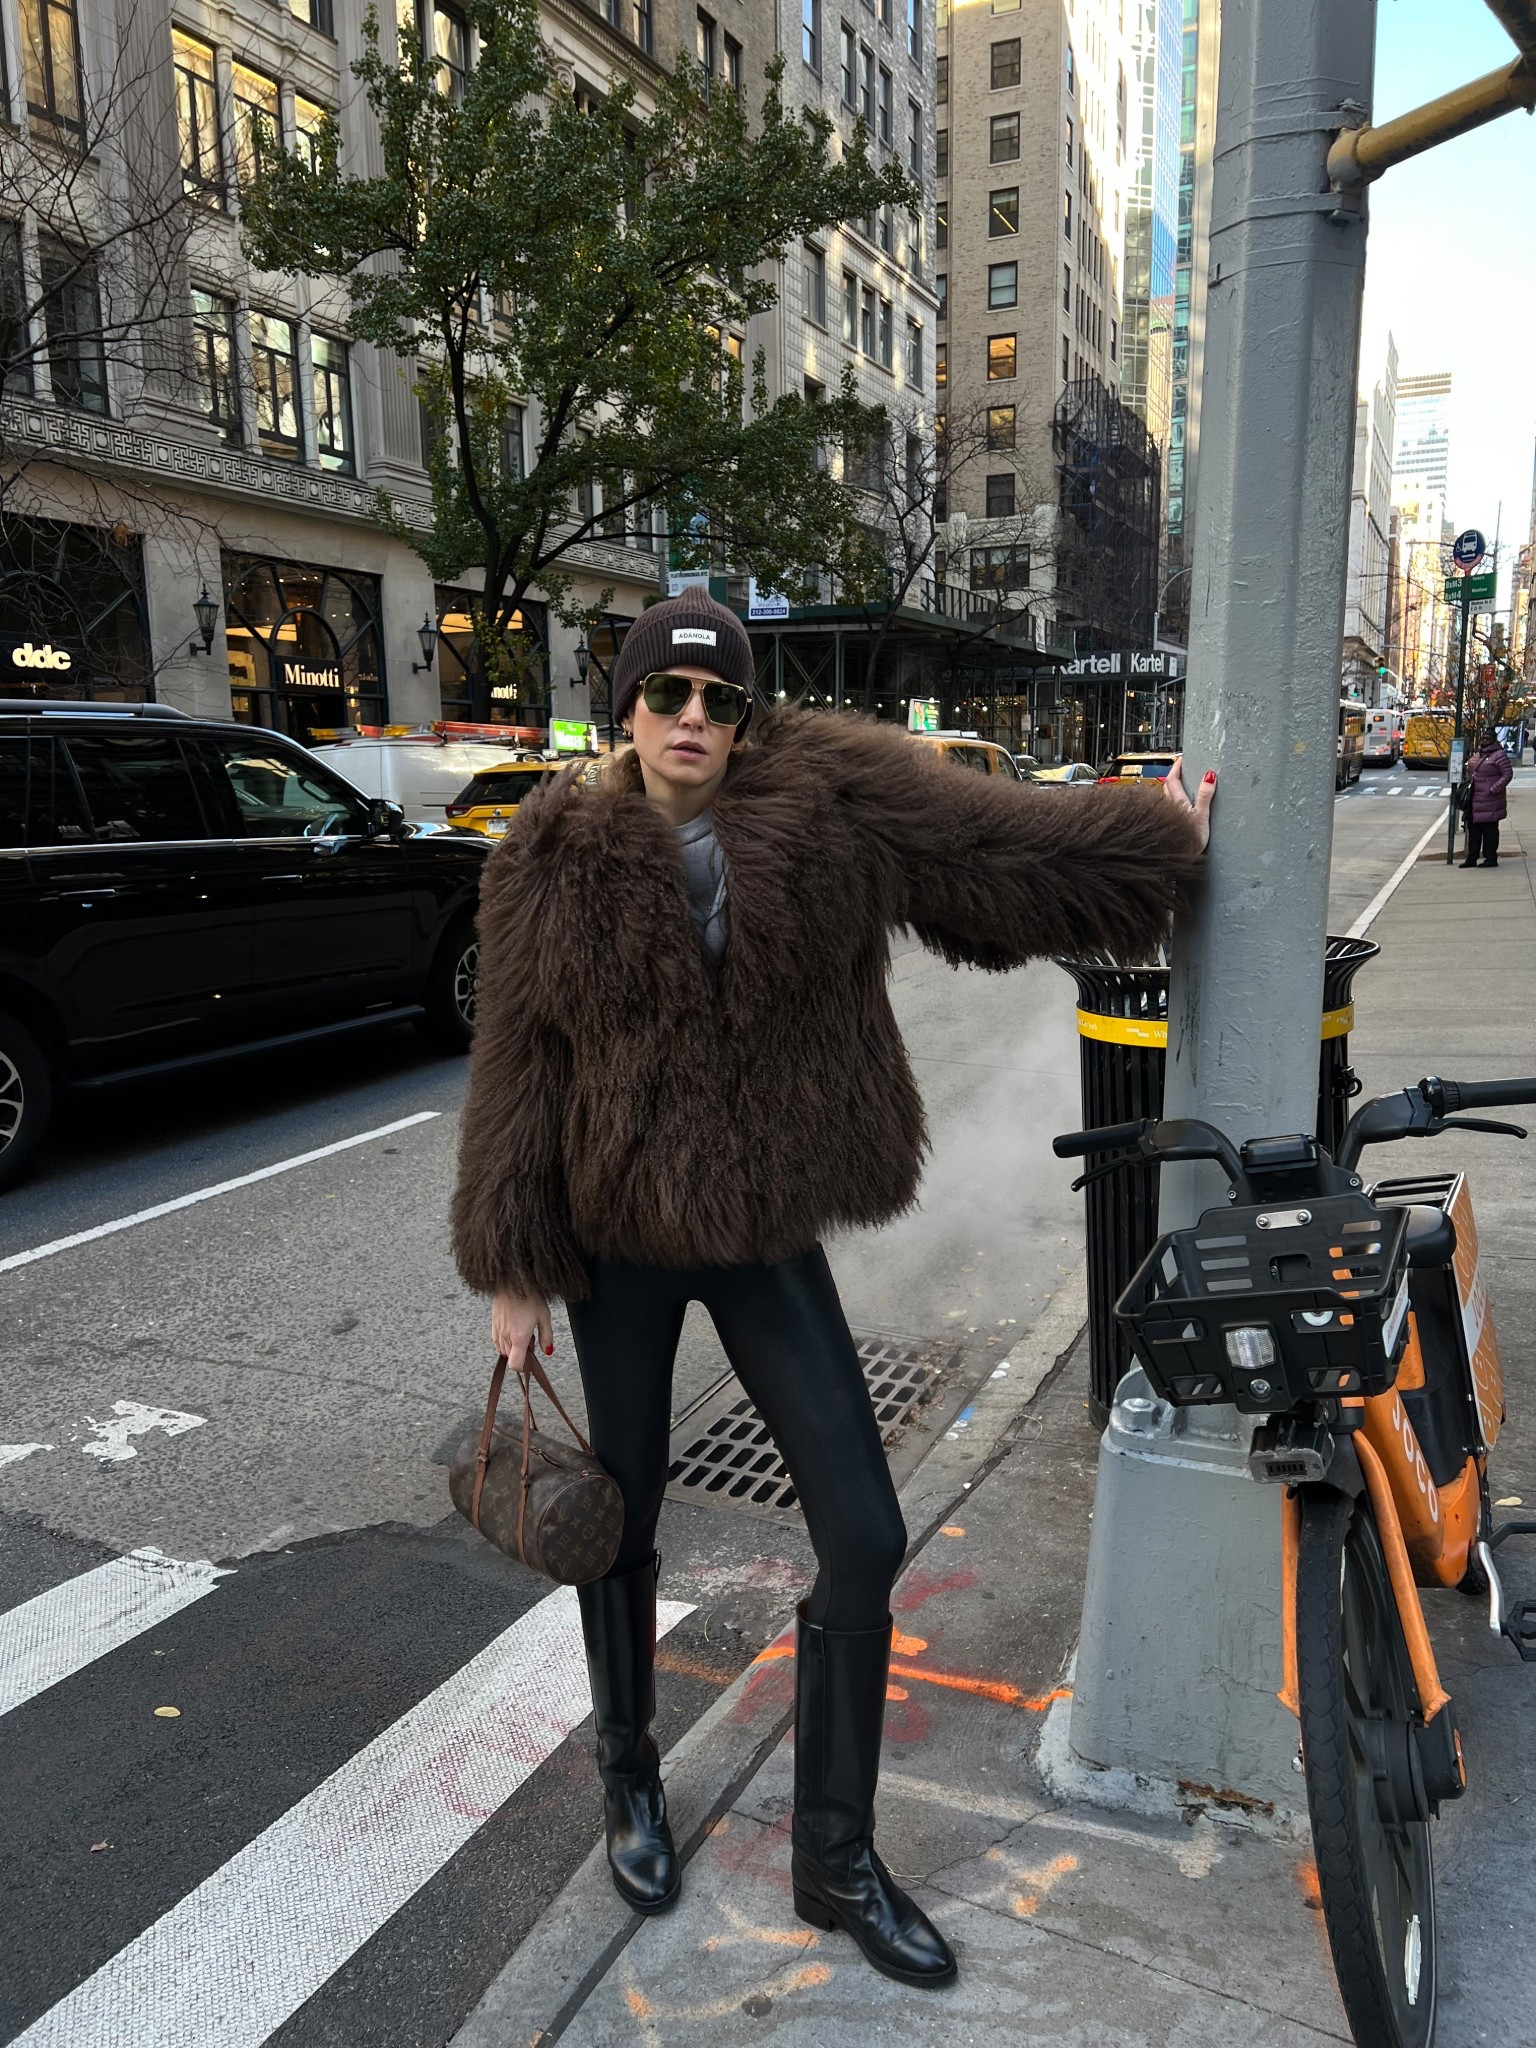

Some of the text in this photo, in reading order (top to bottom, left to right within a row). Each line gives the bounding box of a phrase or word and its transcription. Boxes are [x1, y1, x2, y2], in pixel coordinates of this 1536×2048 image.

[1446, 579, 1462, 588] BxM3
[679, 632, 711, 640] ADANOLA
[12, 642, 72, 671] ddc
[283, 663, 340, 687] Minotti
[1393, 1395, 1438, 1522] JOCO
